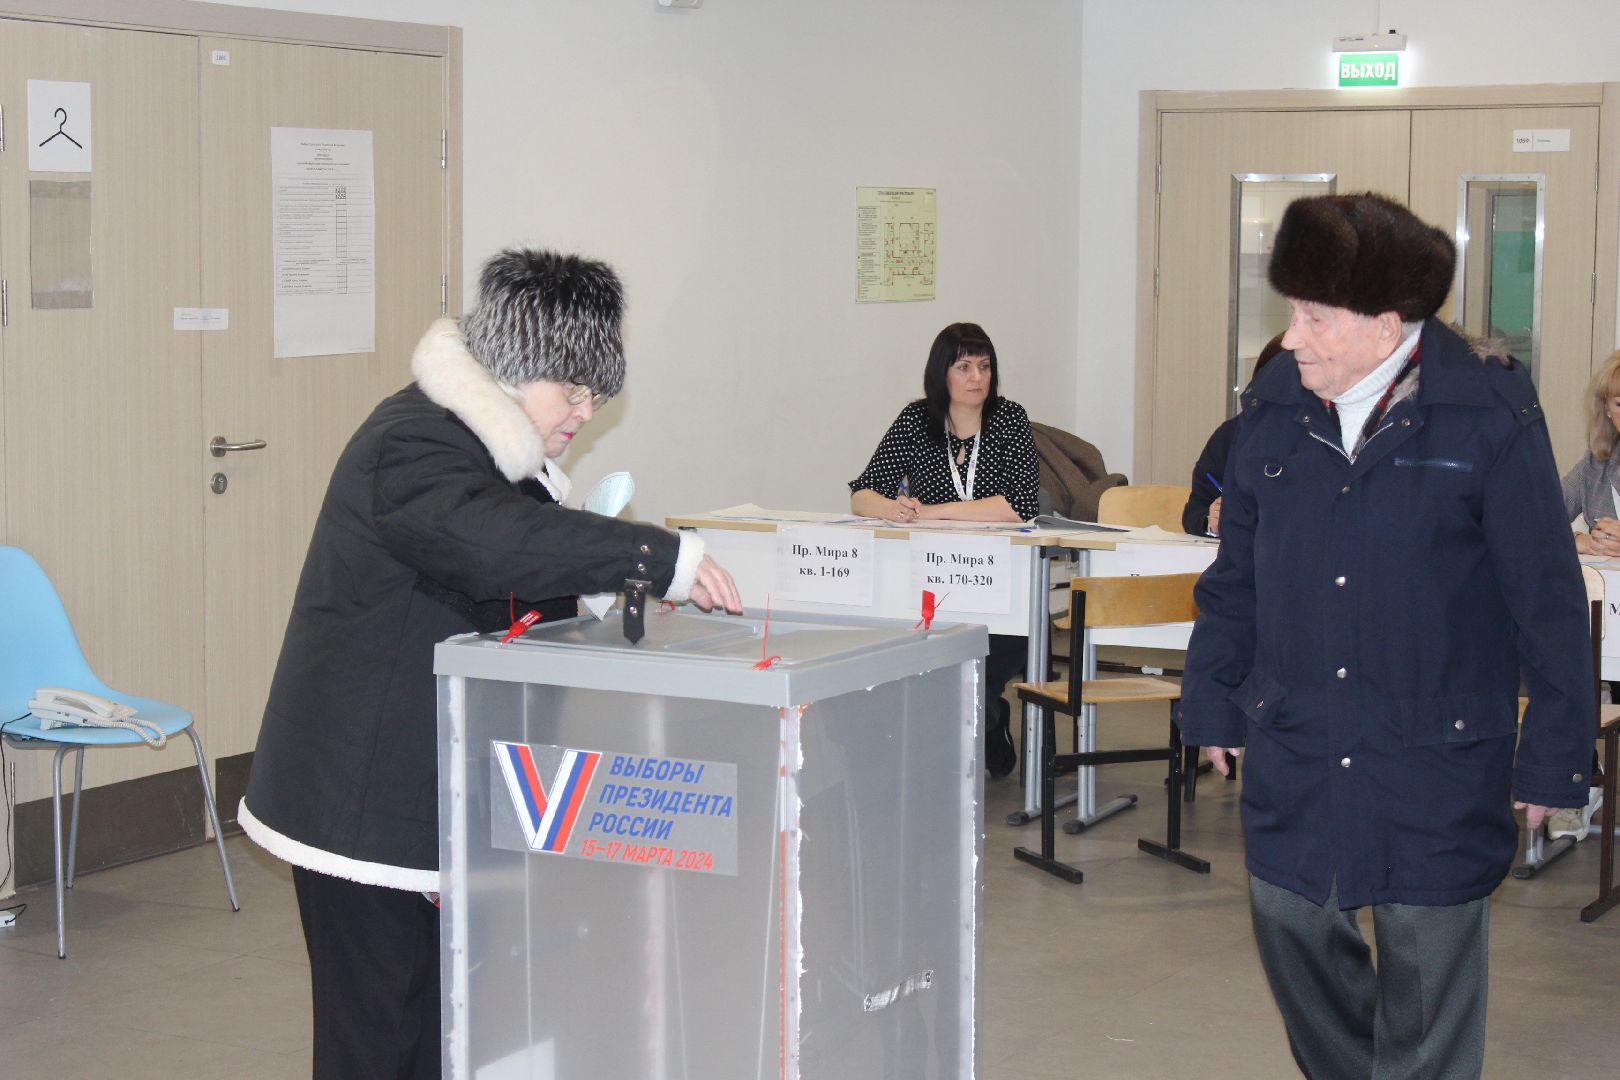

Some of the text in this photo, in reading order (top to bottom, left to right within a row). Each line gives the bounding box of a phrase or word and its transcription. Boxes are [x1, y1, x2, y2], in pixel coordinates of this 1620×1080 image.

[1341, 62, 1396, 80] ВЫХОД
[792, 544, 858, 560] Пр. Мира 8
[926, 552, 994, 568] Пр. Мира 8
[799, 566, 850, 577] кв. 1-169
[927, 574, 993, 586] кв. 170-320
[609, 755, 705, 784] ВЫБОРЫ
[599, 783, 734, 817] ПРЕЗИДЕНТА
[588, 812, 674, 841] РОССИИ
[623, 845, 674, 866] МАРТА
[675, 850, 714, 870] 2024
